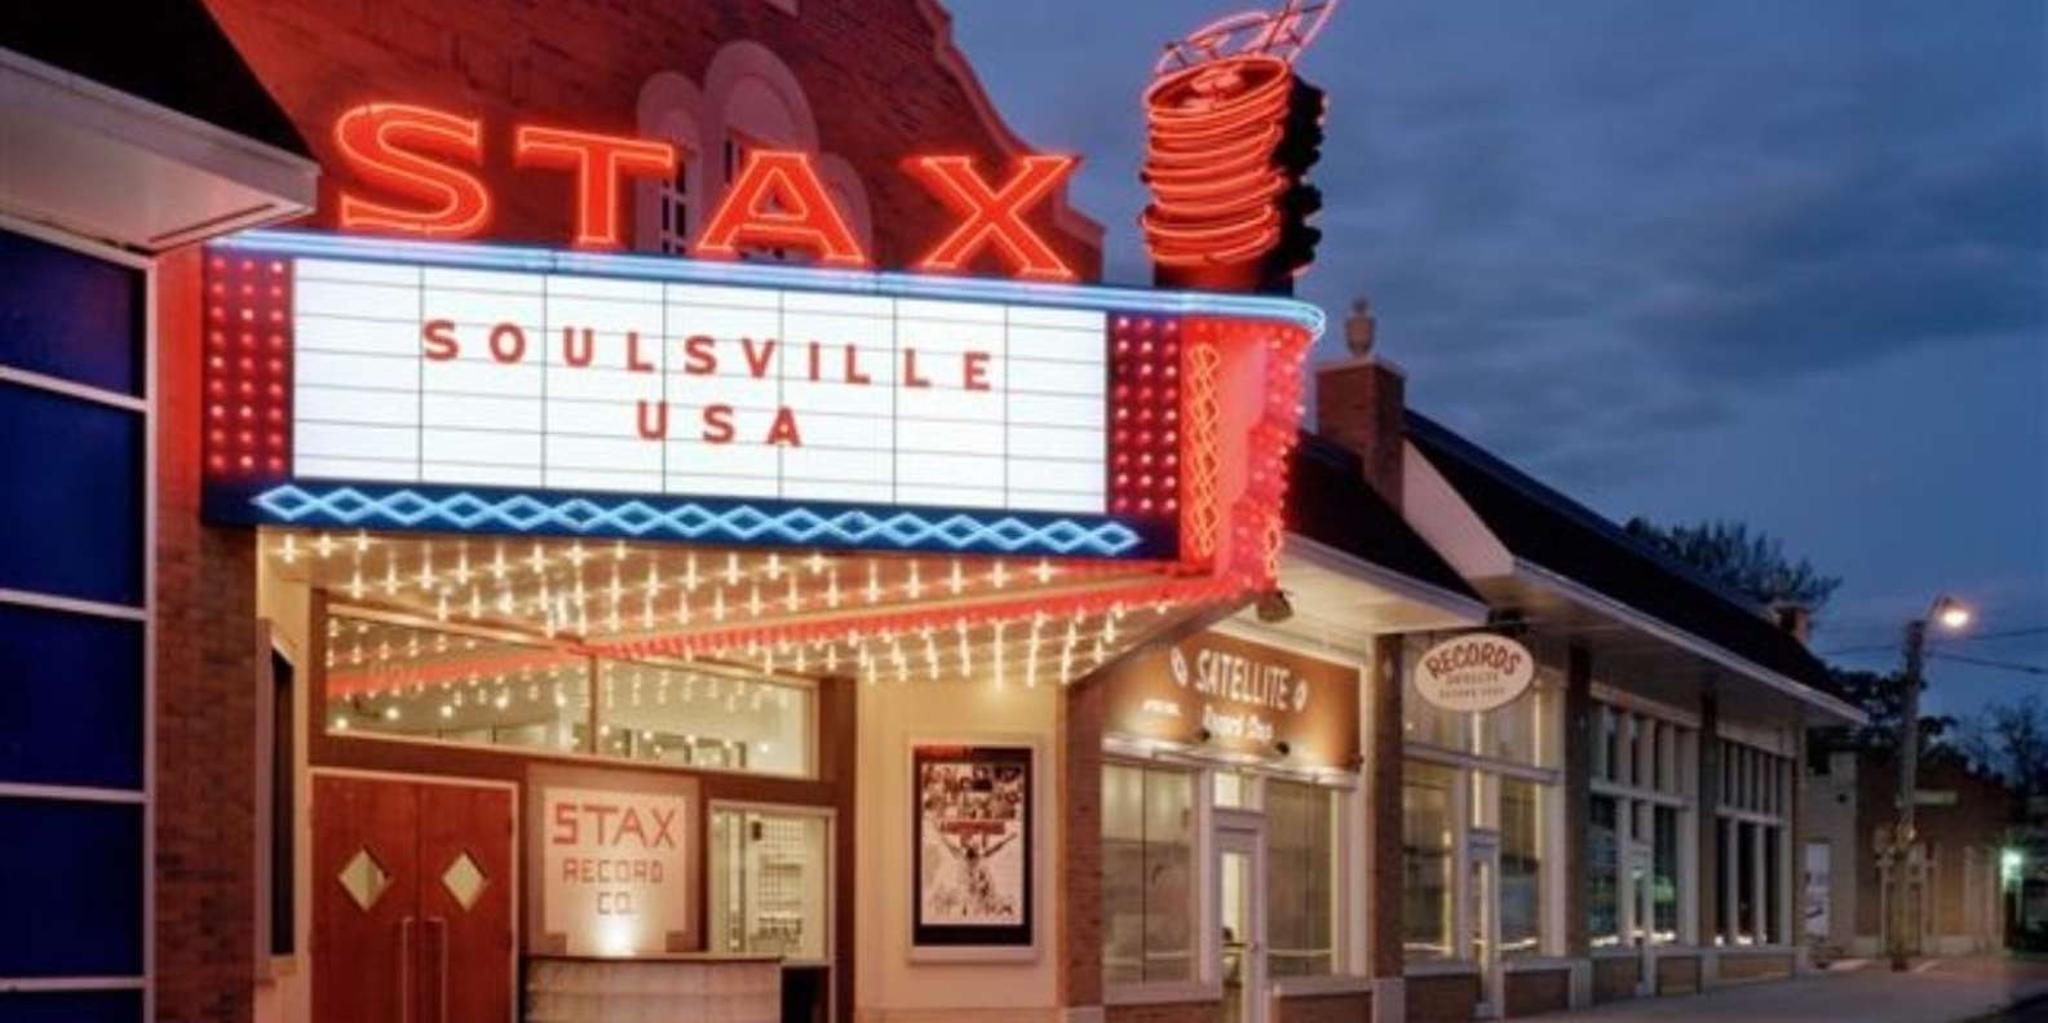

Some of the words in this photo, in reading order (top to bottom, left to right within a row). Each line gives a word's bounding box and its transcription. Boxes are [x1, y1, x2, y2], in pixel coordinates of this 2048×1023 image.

[335, 103, 1079, 278] STAX
[422, 319, 993, 391] SOULSVILLE
[636, 400, 803, 446] USA
[1196, 648, 1291, 710] SATELLITE
[1425, 642, 1522, 679] RECORDS
[553, 803, 677, 848] STAX
[563, 858, 664, 884] RECORD
